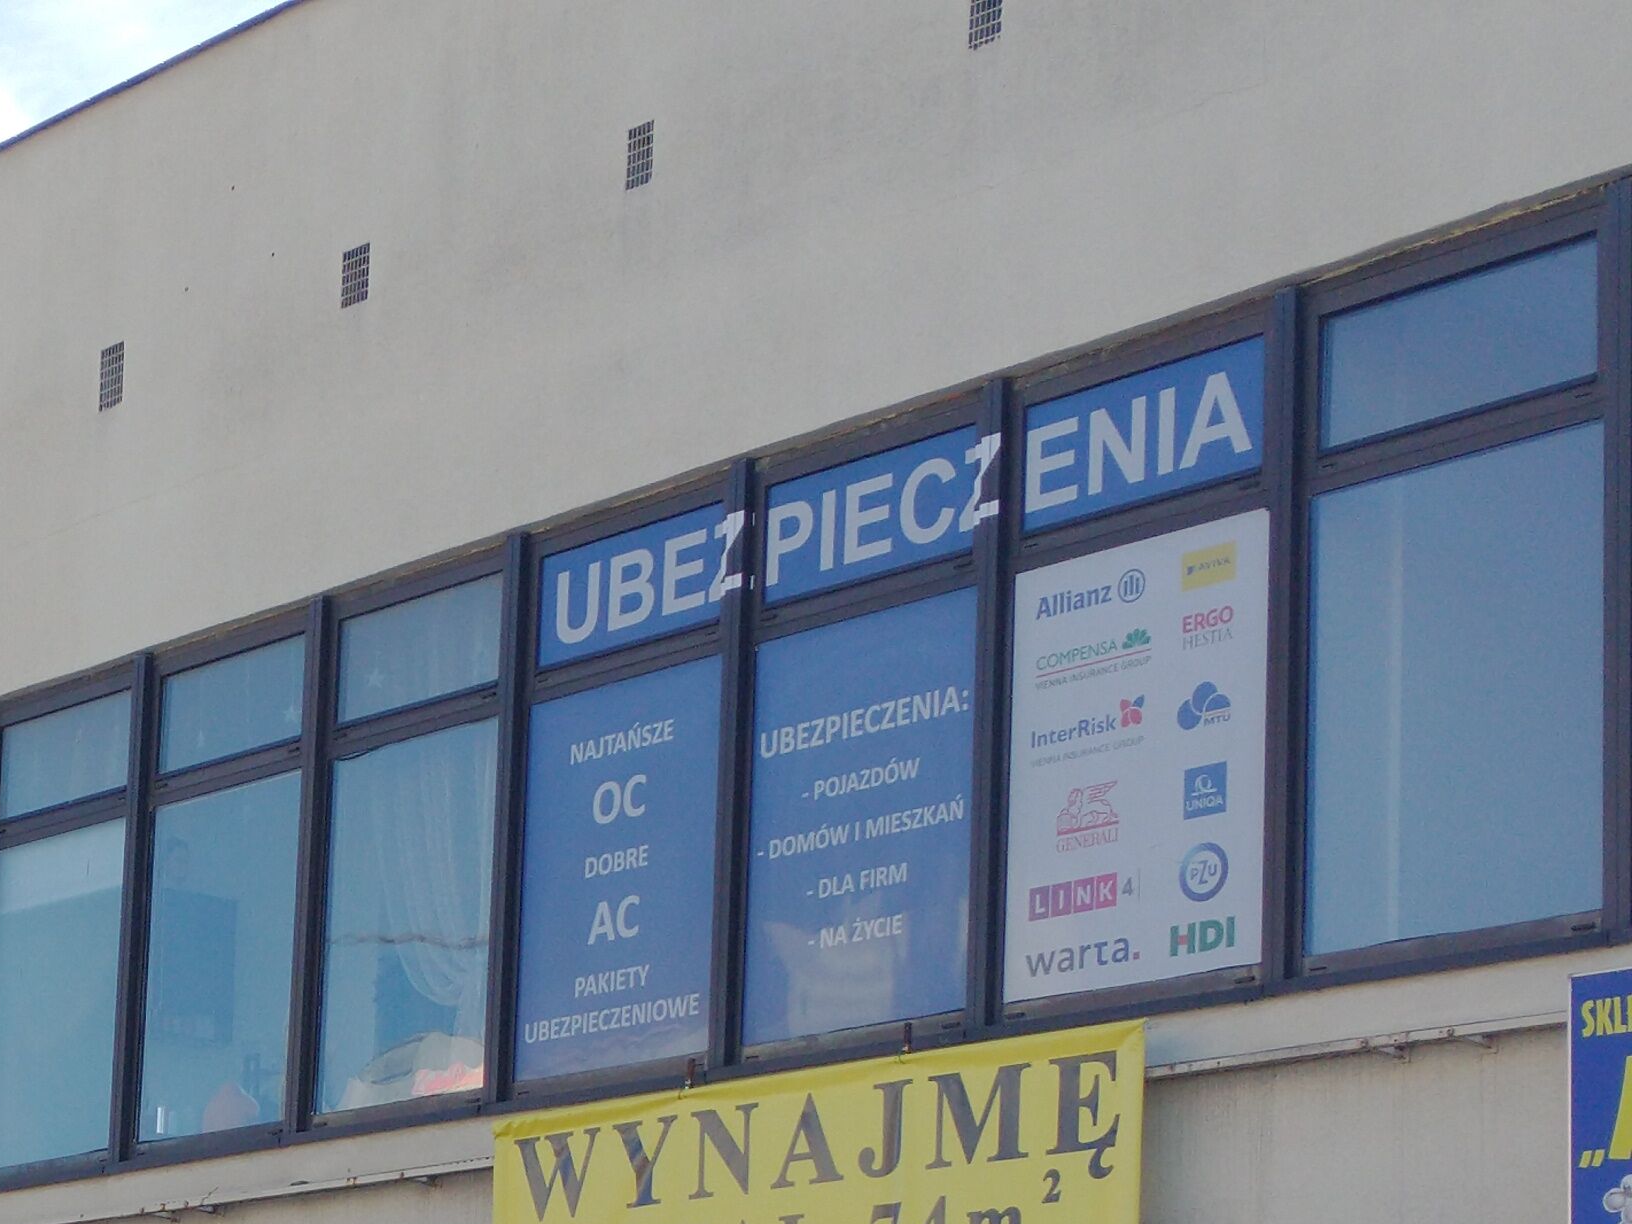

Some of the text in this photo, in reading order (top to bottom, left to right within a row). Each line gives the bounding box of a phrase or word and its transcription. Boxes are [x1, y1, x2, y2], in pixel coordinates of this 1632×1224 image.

[1035, 583, 1112, 621] Allianz
[1183, 605, 1234, 634] ERGO
[1035, 640, 1118, 671] COMPENSA
[1182, 628, 1233, 651] HESTIA
[760, 686, 969, 759] UBEZPIECZENIA:
[1031, 714, 1117, 749] InterRisk
[1204, 711, 1231, 727] MTU
[570, 718, 675, 766] NAJTAŃSZE
[814, 757, 920, 801] POJAZDÓW
[592, 774, 647, 825] OC
[1185, 795, 1224, 811] UNIQA
[768, 823, 849, 860] DOMÓW
[865, 793, 964, 839] MIESZKAŃ
[1056, 829, 1119, 853] GENERALI
[584, 845, 649, 880] DOBRE
[818, 862, 908, 900] DLA FIRM
[1190, 857, 1218, 885] PZU
[1033, 879, 1115, 917] LINK
[587, 895, 640, 946] AC
[820, 914, 903, 949] NA ŻYCIE
[1170, 915, 1236, 957] HDI
[574, 964, 650, 999] PAKIETY
[524, 993, 701, 1044] UBEZPIECZENIOWE
[1581, 994, 1632, 1038] SKL
[514, 1050, 1121, 1223] WYNAJMĘ
